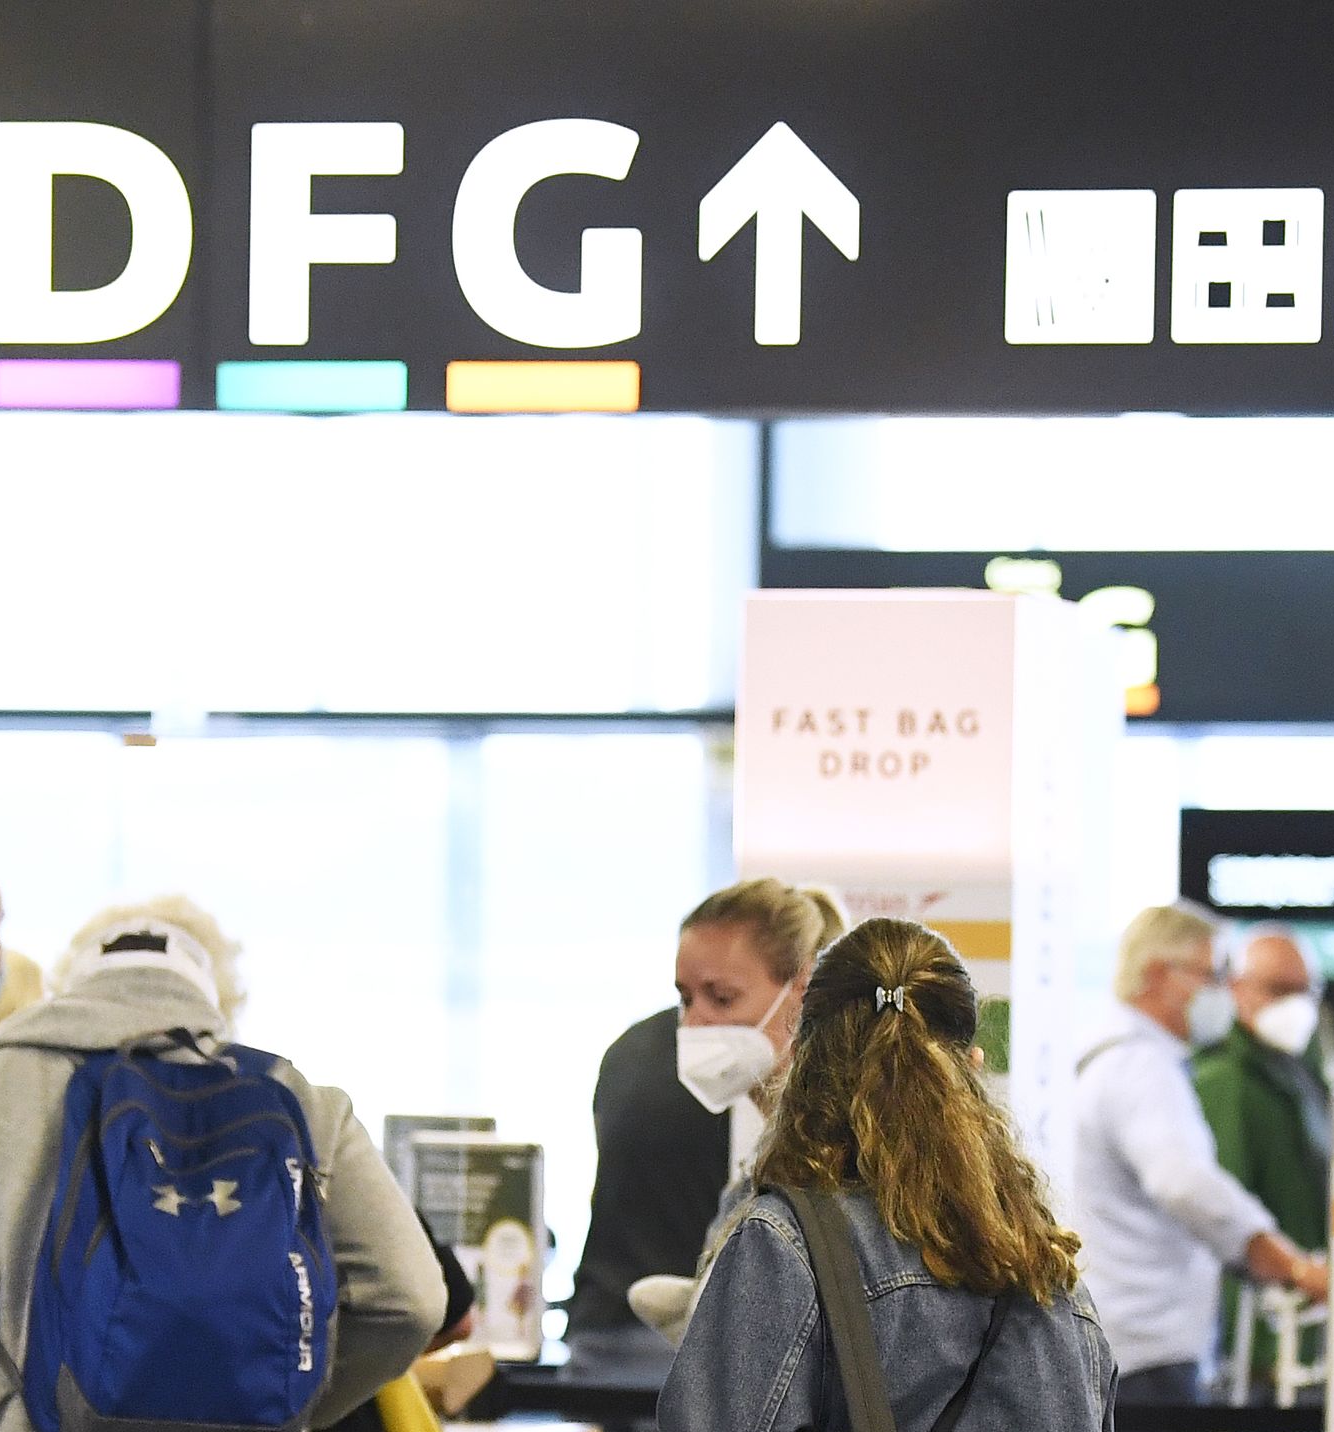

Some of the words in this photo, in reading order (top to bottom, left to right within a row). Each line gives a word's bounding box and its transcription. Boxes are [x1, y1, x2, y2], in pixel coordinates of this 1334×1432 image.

[771, 707, 871, 736] FAST
[897, 707, 980, 737] BAG
[818, 749, 931, 779] DROP
